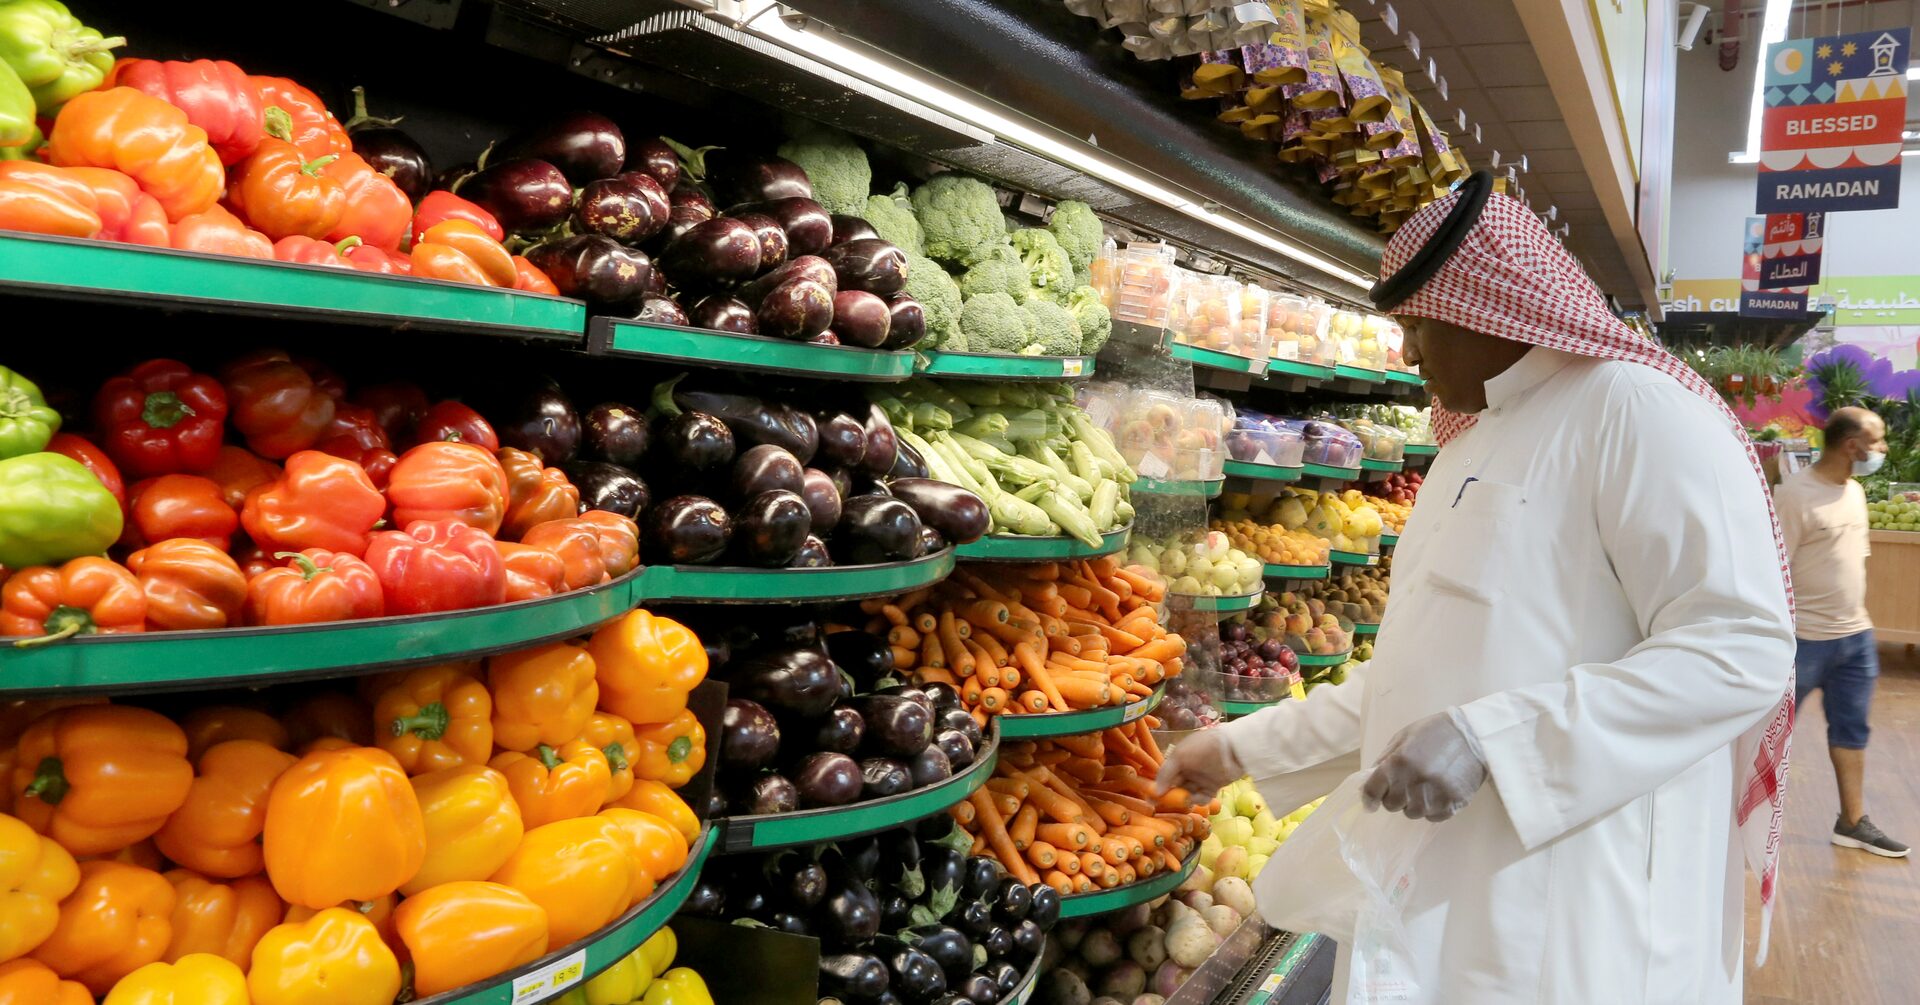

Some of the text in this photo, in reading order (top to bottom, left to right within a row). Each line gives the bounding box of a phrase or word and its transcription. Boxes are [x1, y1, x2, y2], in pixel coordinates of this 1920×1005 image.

[1786, 114, 1878, 136] BLESSED
[1776, 180, 1880, 200] RAMADAN
[1769, 215, 1796, 240] وأنتم
[1769, 261, 1808, 280] العطاء
[1709, 297, 1741, 312] cu
[1748, 299, 1799, 310] RAMADAN
[1837, 288, 1920, 316] طبيعية
